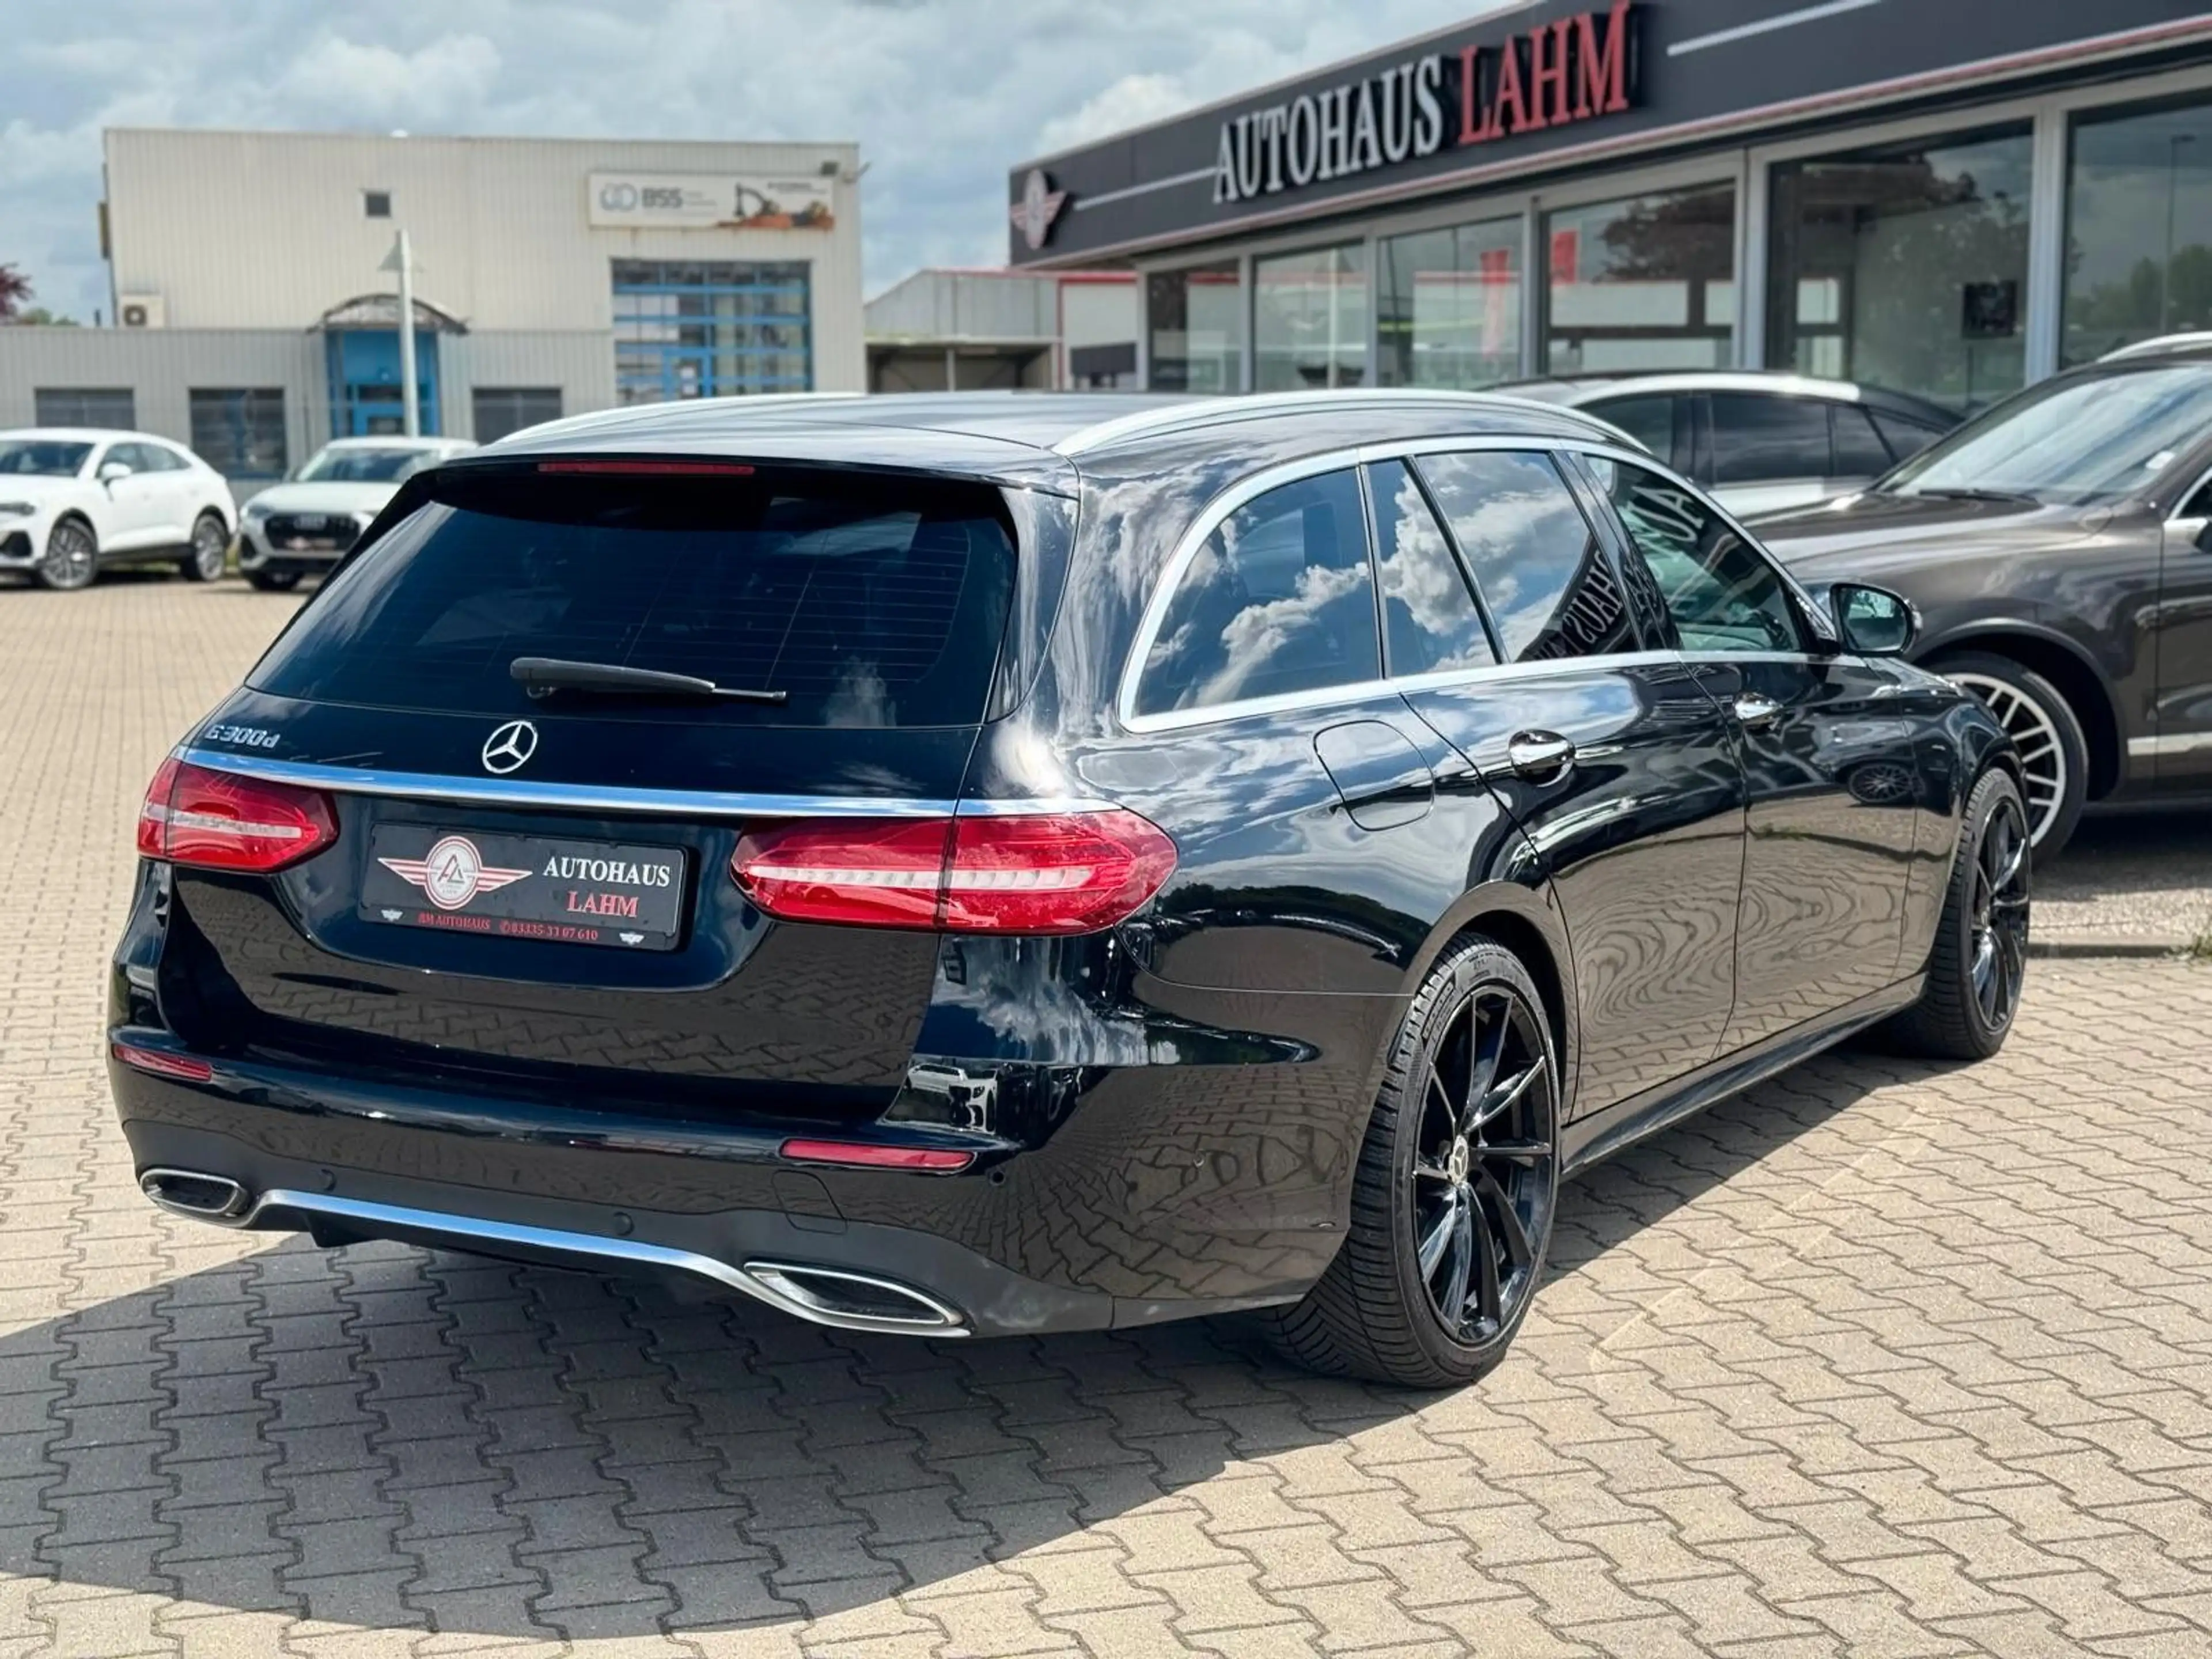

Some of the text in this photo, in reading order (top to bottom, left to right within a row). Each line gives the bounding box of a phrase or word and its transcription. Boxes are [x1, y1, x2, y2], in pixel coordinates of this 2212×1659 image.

[1213, 0, 1630, 204] AUTOHAUS LAHM
[543, 855, 671, 887] AUTOHAUS
[566, 890, 640, 918] LAHM
[577, 928, 599, 941] 610
